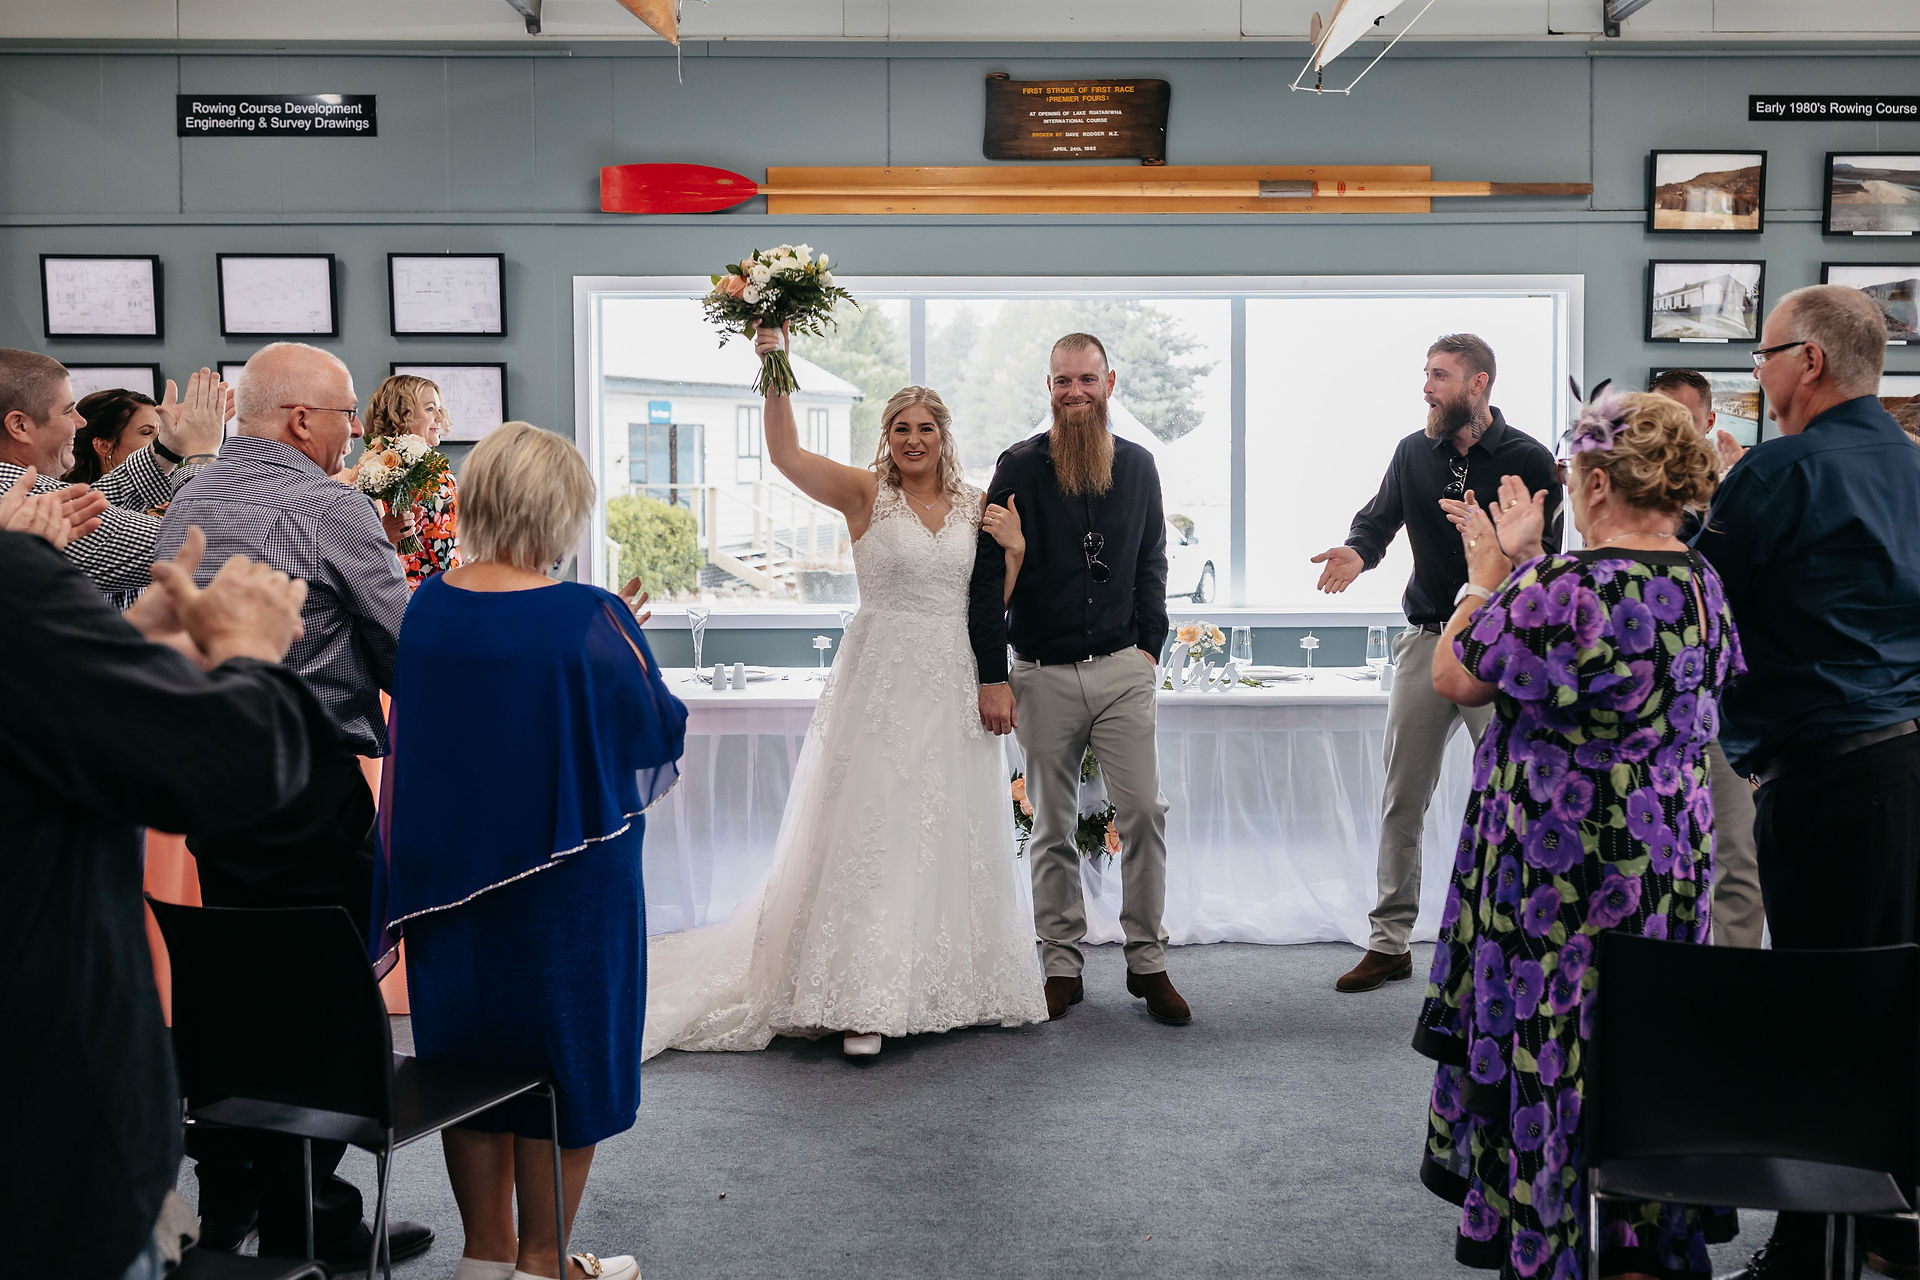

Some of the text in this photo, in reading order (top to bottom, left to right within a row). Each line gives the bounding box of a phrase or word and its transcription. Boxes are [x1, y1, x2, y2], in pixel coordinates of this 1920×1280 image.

[1022, 87, 1043, 95] FIRST
[1114, 85, 1135, 93] RACE
[192, 102, 362, 116] Rowing Course Development
[1756, 101, 1918, 116] Early 1980's Rowing Course
[185, 117, 370, 131] Engineering & Survey Drawings
